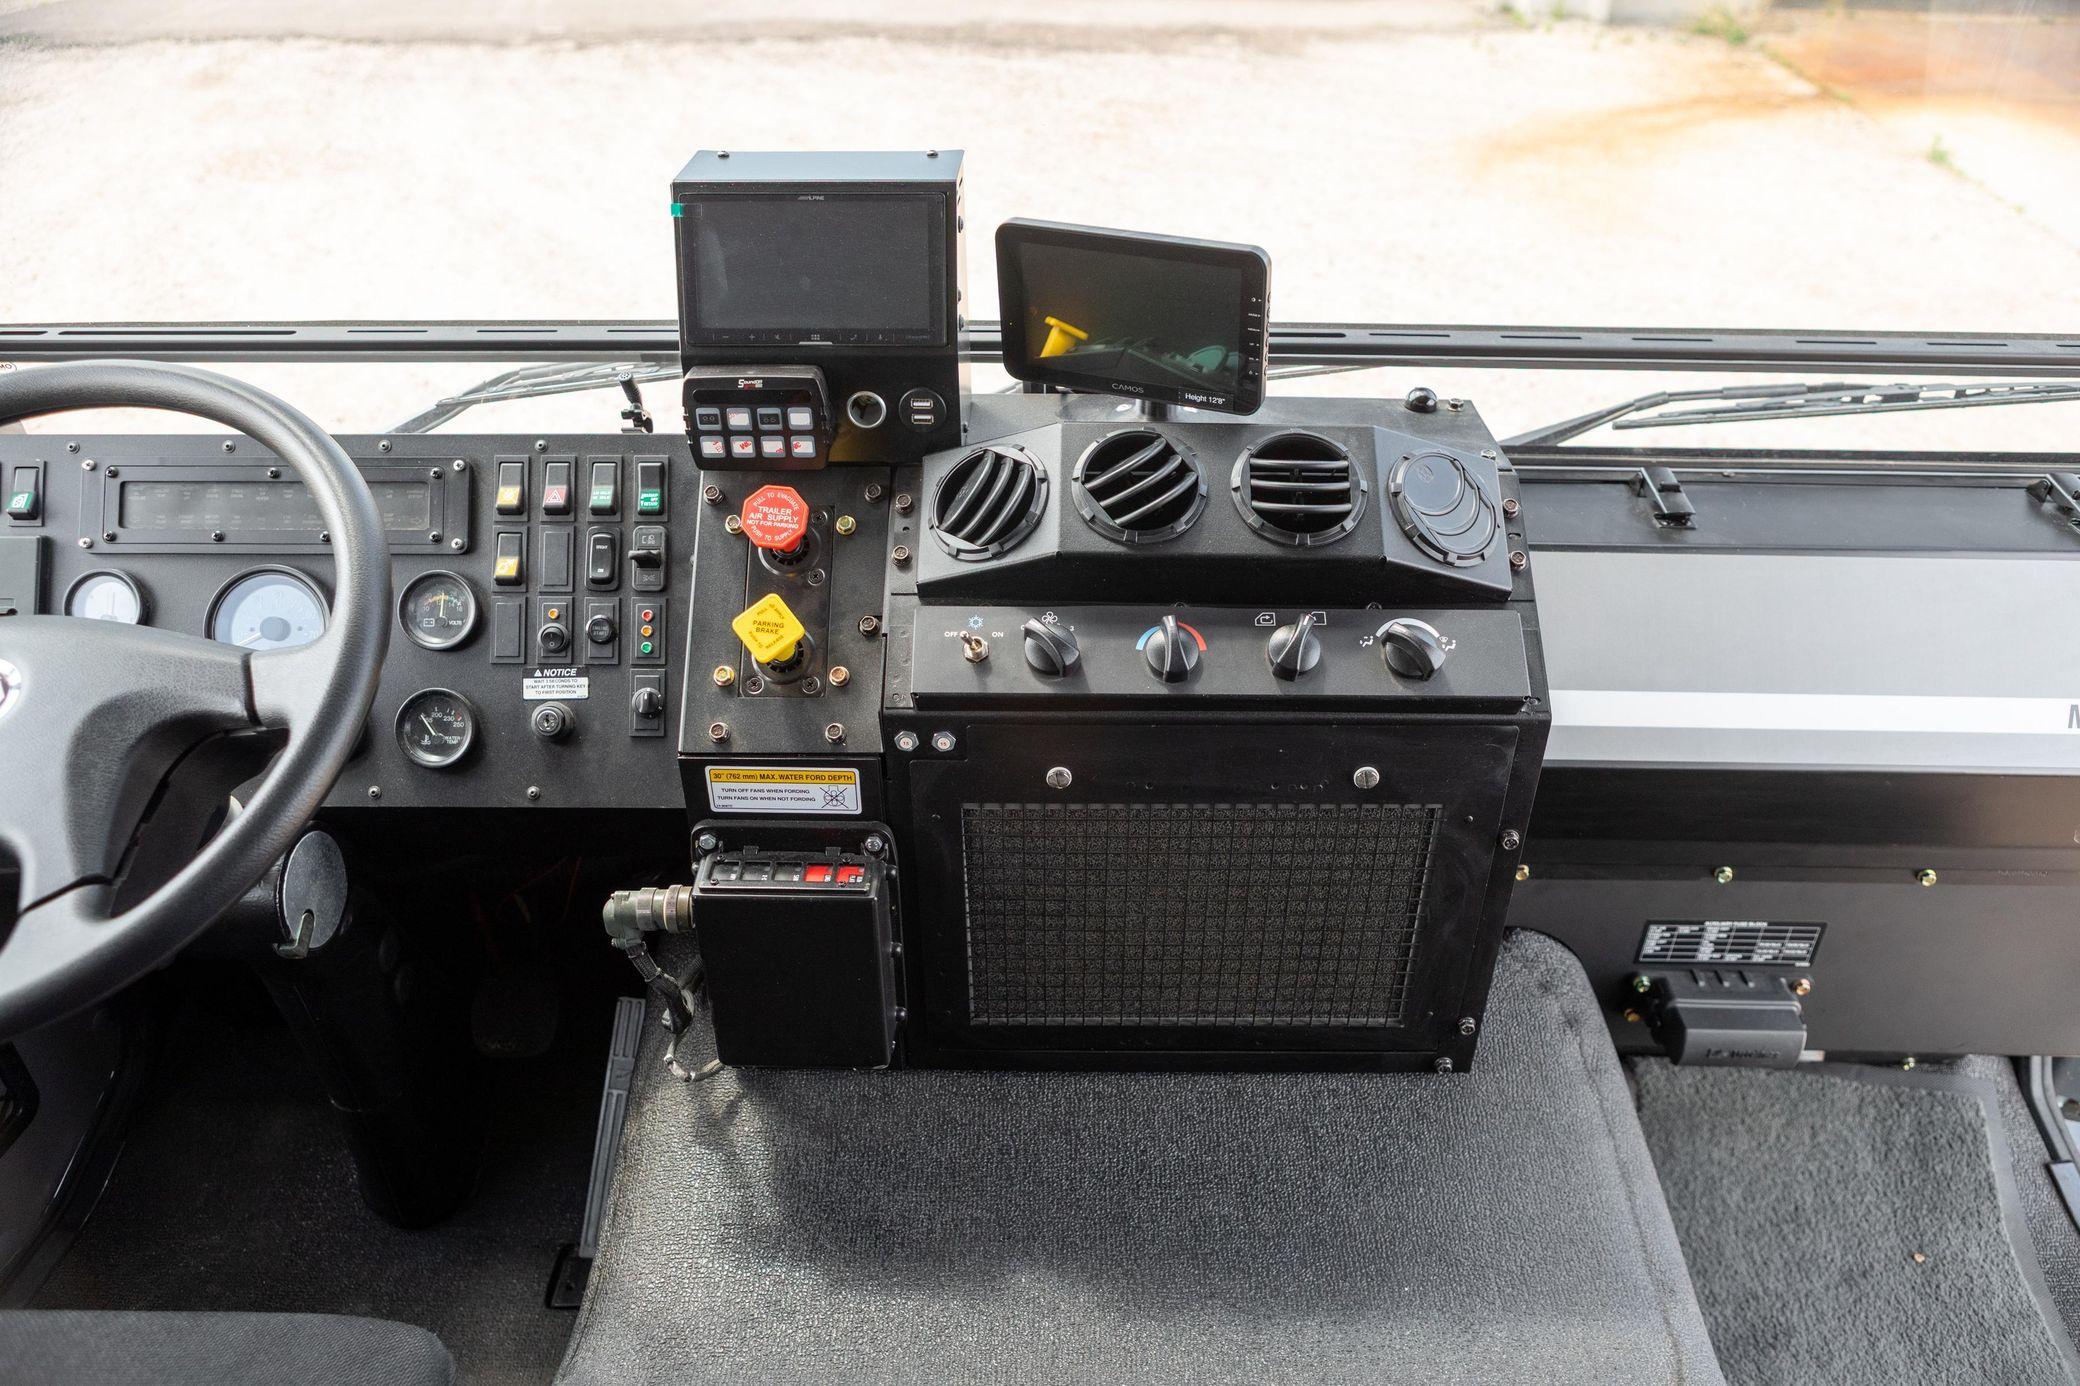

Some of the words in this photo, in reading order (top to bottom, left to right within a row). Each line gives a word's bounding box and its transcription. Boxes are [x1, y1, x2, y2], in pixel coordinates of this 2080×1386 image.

[1111, 383, 1144, 394] CAMOS
[1185, 392, 1207, 403] Height
[777, 492, 800, 511] EVACUATE
[758, 505, 793, 516] TRAILER
[749, 512, 763, 520] AIR
[767, 513, 799, 523] SUPPLY
[753, 620, 785, 629] PARKING
[755, 627, 780, 635] BRAKE
[543, 668, 577, 677] NOTICE
[742, 773, 758, 781] mm)
